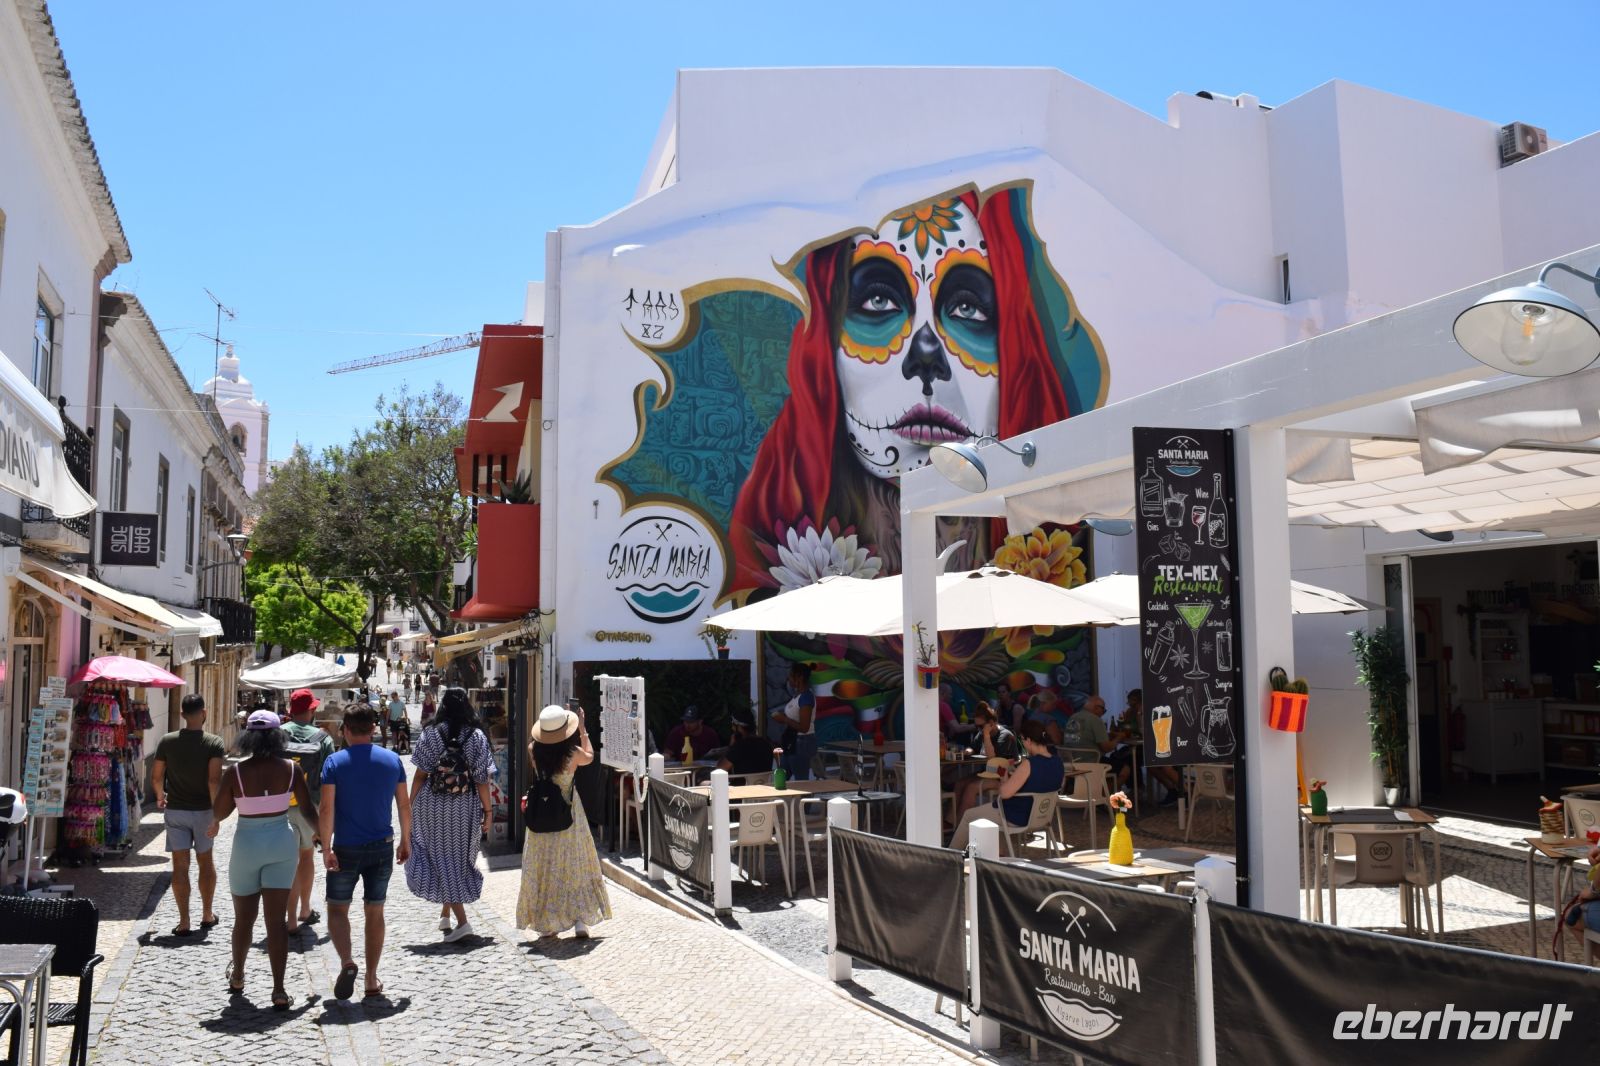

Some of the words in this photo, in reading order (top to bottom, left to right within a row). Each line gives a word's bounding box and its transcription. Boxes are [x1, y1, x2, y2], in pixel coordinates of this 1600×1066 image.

[1158, 449, 1183, 459] SANTA
[1184, 450, 1209, 460] MARIA
[1195, 487, 1209, 499] Wine
[111, 526, 127, 552] SIDE
[134, 527, 151, 553] BAR
[607, 543, 661, 579] SANTA
[1158, 565, 1218, 581] TEX-MEX
[1148, 601, 1169, 611] Cocktails
[1019, 927, 1073, 973] SANTA
[1079, 943, 1141, 993] MARIA
[1044, 968, 1091, 997] Restaurante
[1098, 984, 1116, 1005] Bar
